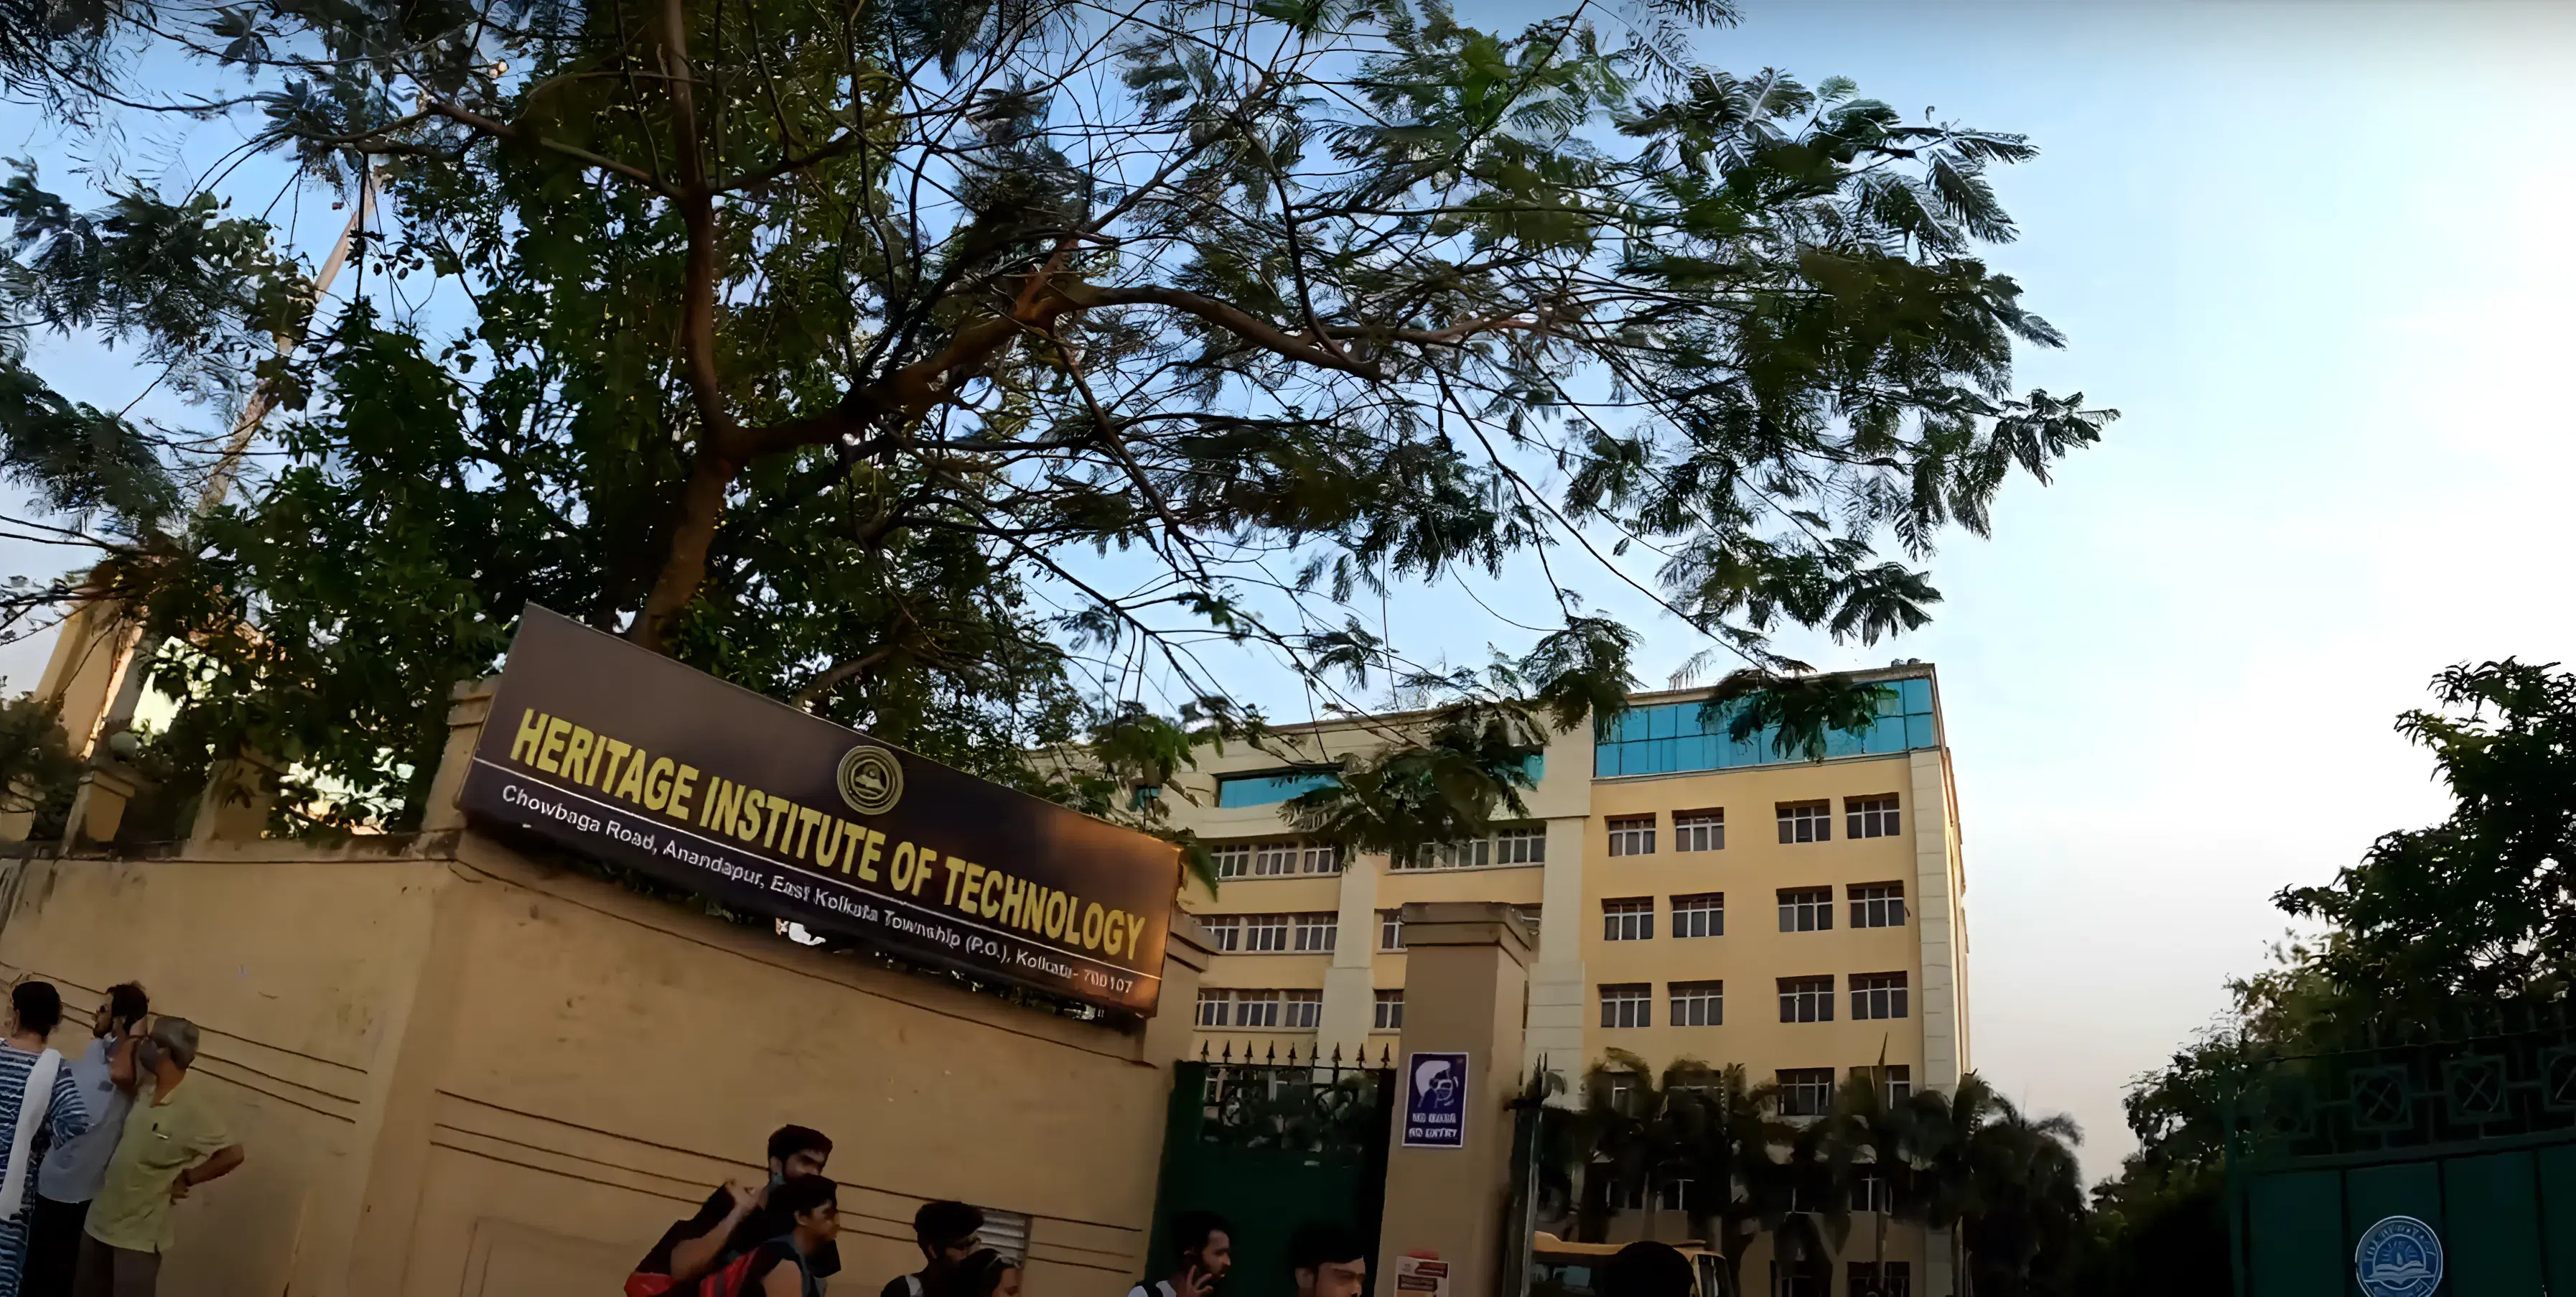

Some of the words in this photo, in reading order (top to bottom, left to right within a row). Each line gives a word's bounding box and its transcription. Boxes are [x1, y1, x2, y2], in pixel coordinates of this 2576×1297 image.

[502, 784, 601, 832] Chowbaga
[605, 820, 658, 855] Road,
[662, 840, 765, 889] Anandapur,
[770, 875, 811, 902] East
[813, 888, 879, 922] Kolkata
[884, 909, 961, 949] Township
[966, 934, 1011, 964] (P.O.),
[510, 707, 699, 820] HERITAGE
[699, 776, 886, 883] INSTITUTE
[890, 841, 938, 897] OF
[943, 856, 1146, 960] TECHNOLOGY
